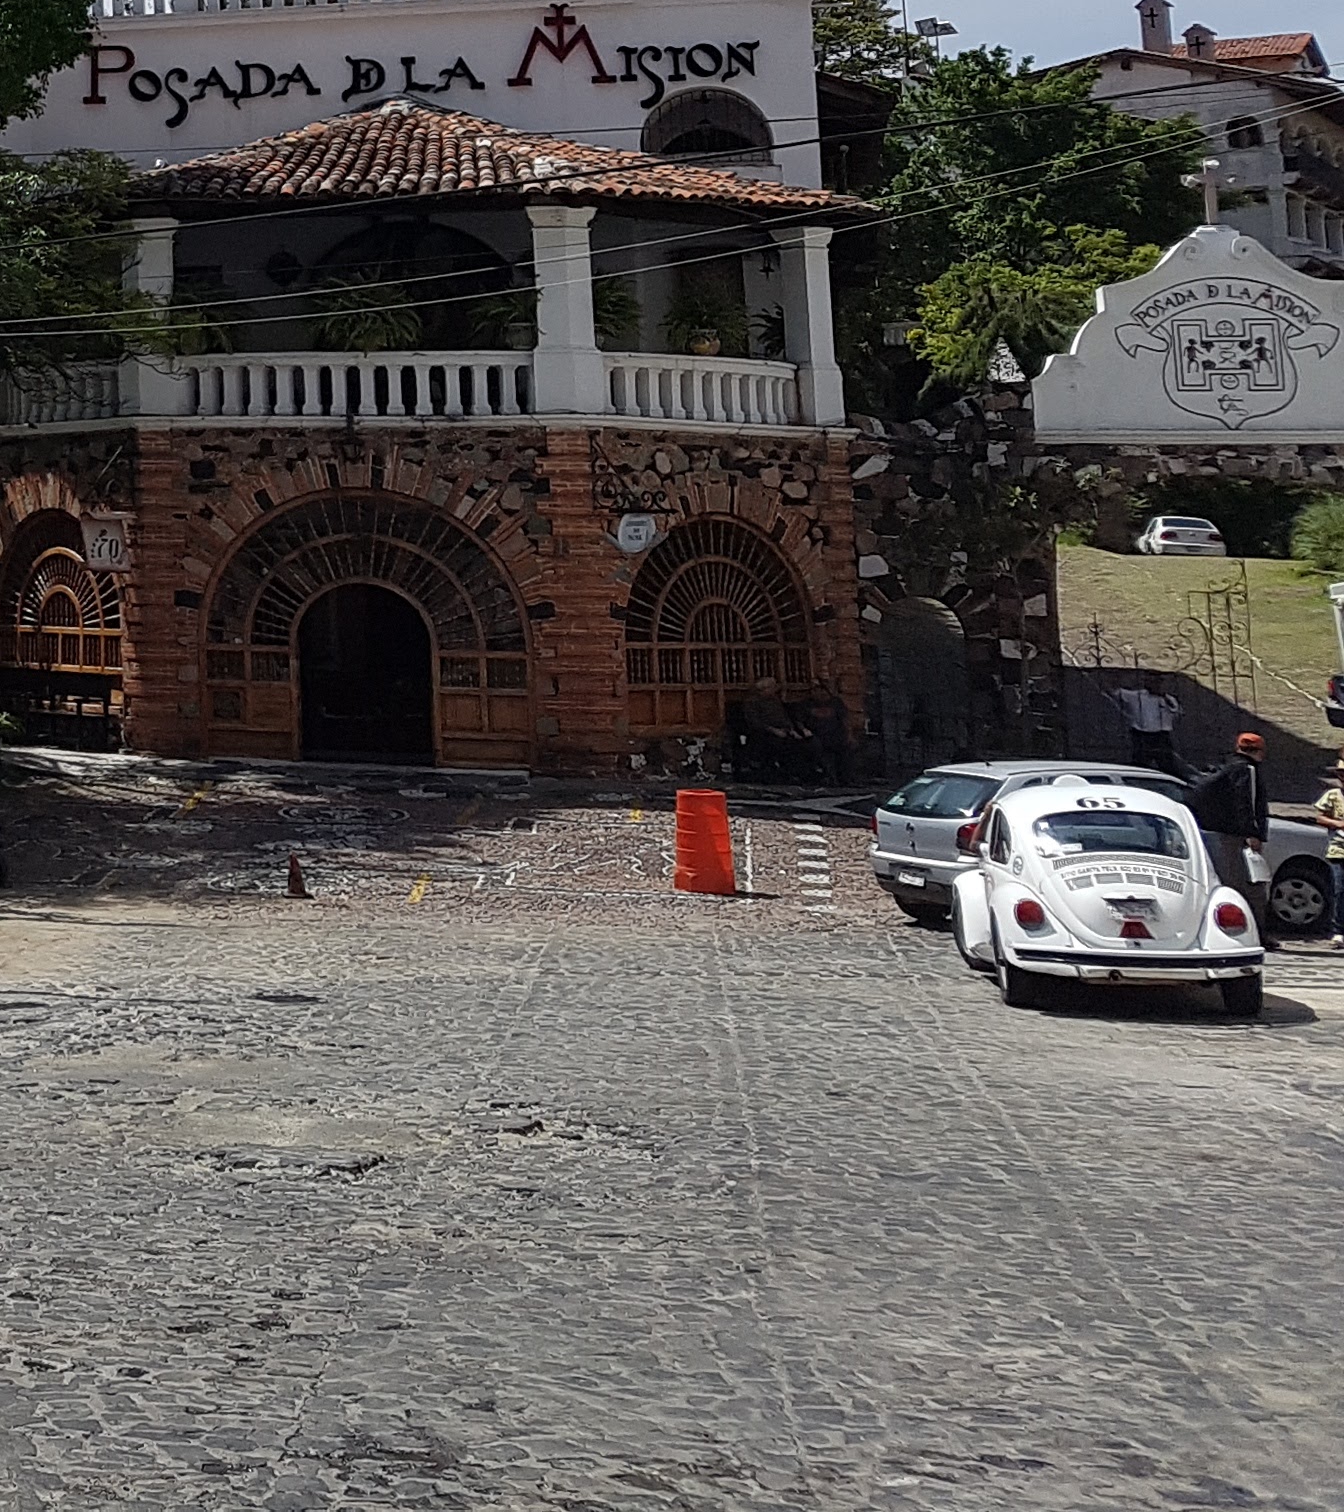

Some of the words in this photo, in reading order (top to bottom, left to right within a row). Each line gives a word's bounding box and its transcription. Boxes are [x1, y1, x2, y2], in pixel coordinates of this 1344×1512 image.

[1134, 289, 1199, 328] POSADA
[1226, 284, 1252, 300] LA
[1075, 796, 1127, 809] 65
